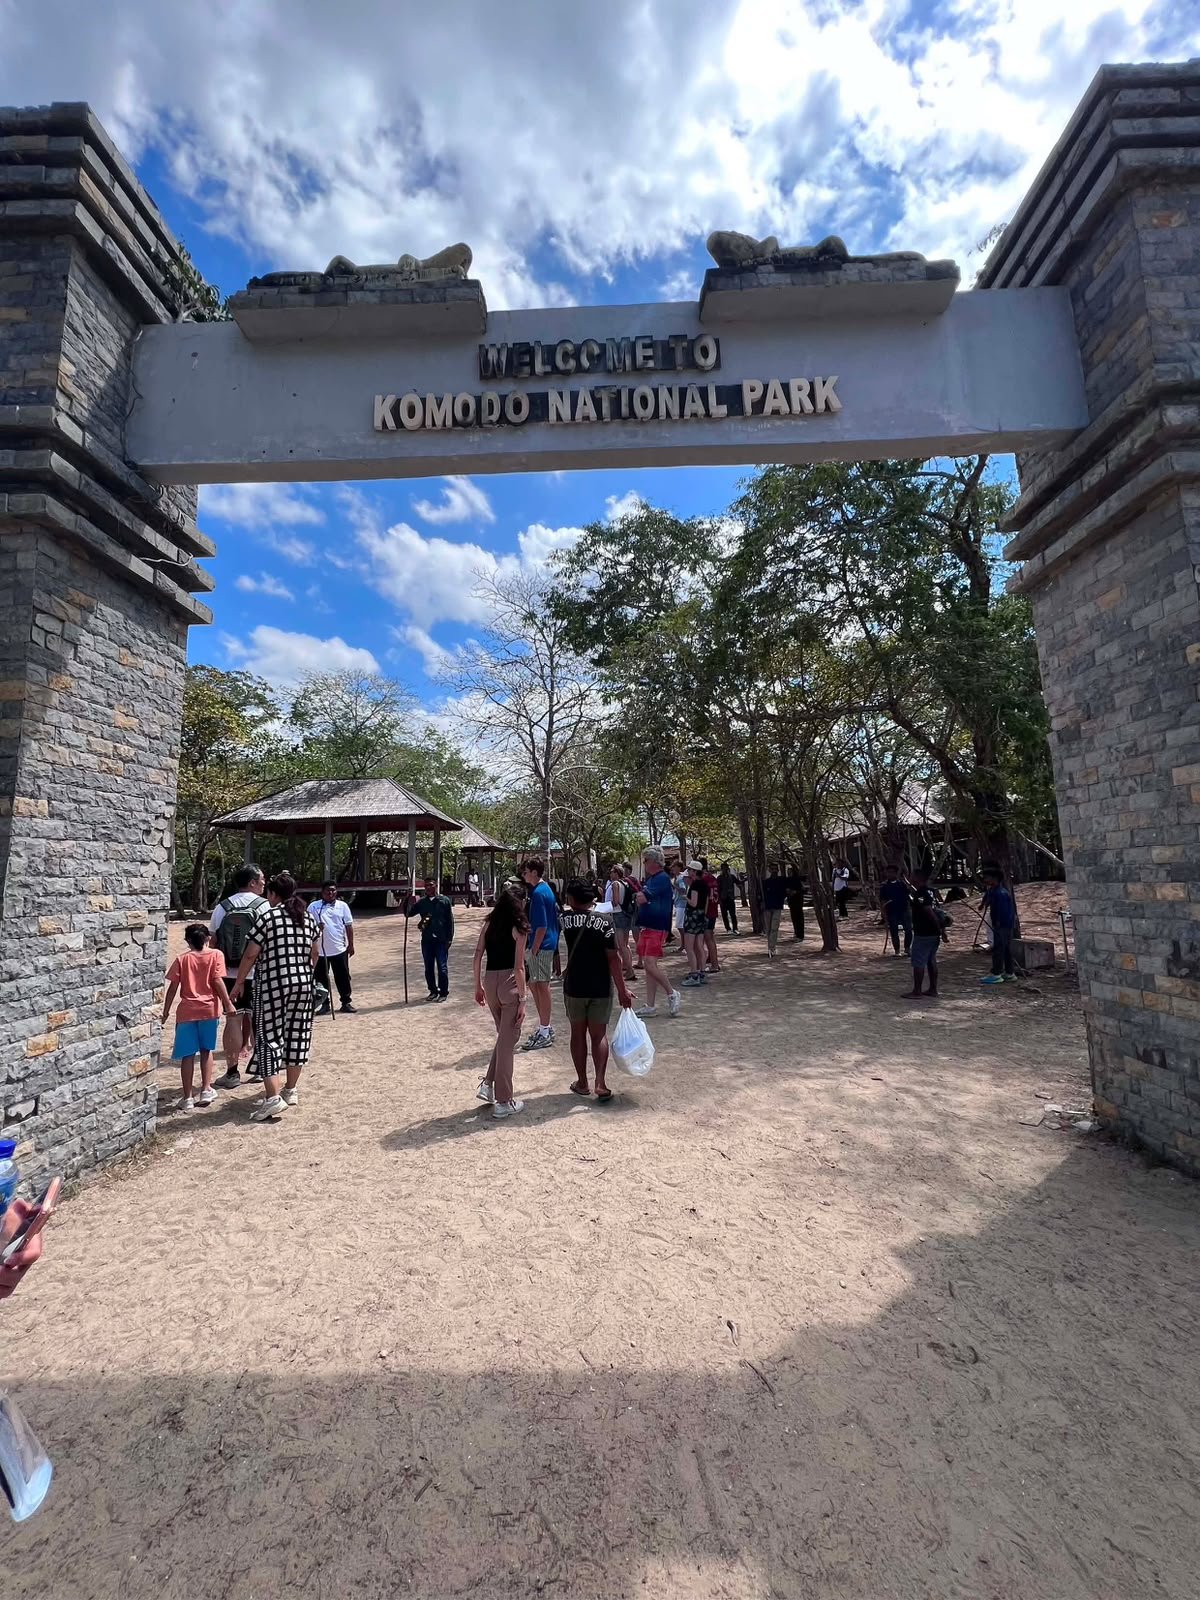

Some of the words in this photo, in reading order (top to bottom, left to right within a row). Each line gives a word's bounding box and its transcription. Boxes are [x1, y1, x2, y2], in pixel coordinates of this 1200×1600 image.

[479, 335, 655, 378] WELCOME
[669, 334, 718, 372] TO
[373, 391, 530, 430] KOMODO
[547, 382, 728, 424] NATIONAL
[742, 375, 842, 417] PARK
